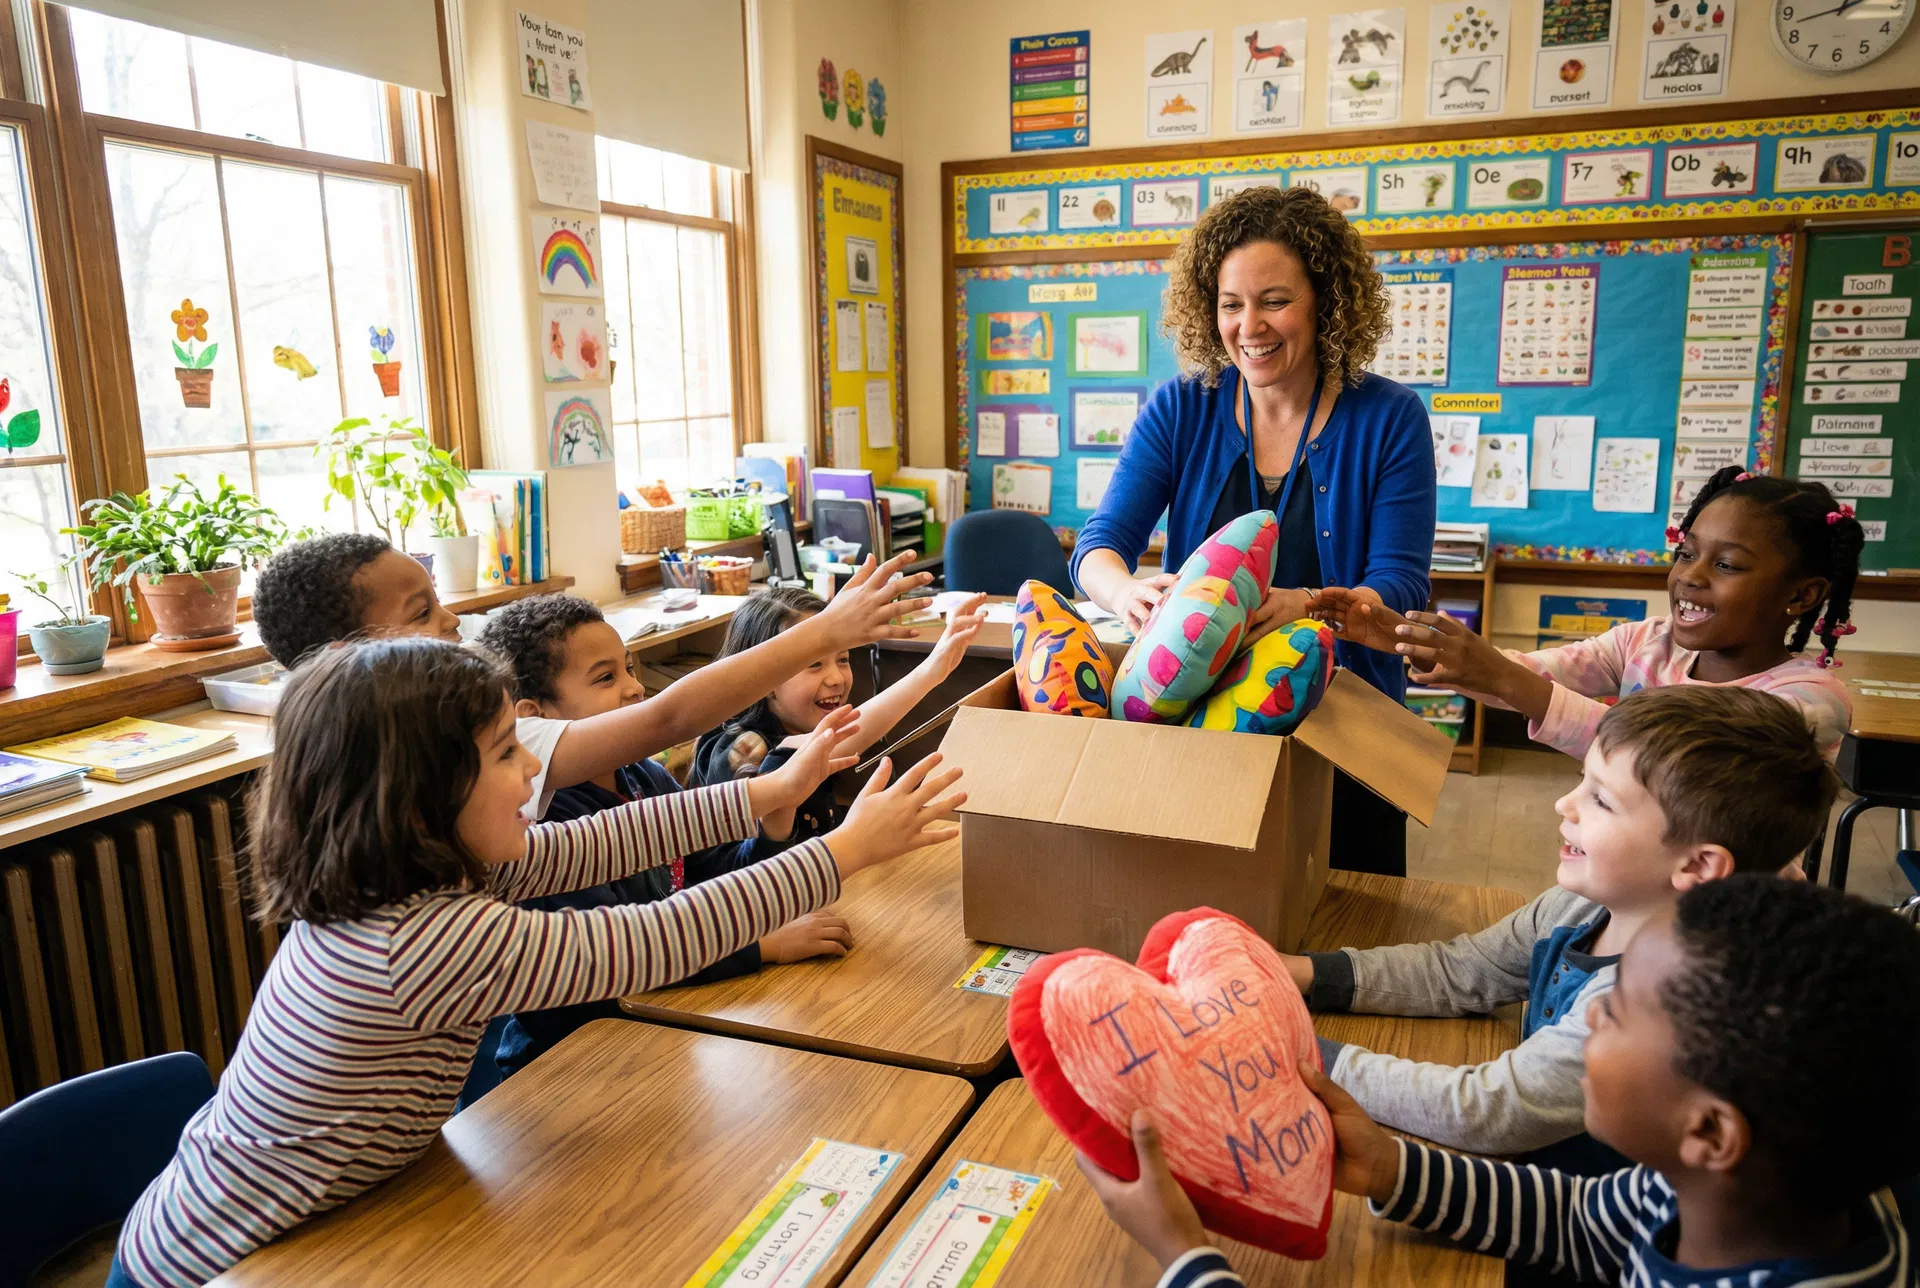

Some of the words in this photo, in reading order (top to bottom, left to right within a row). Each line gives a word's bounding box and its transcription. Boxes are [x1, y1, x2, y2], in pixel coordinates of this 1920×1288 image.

[1783, 6, 1794, 20] 9
[1879, 21, 1890, 35] 4
[1789, 29, 1800, 44] 8
[1808, 44, 1818, 58] 7
[1859, 40, 1870, 54] 5
[1832, 48, 1843, 62] 6
[1671, 154, 1701, 172] Ob
[1382, 173, 1404, 190] Sh
[1474, 168, 1501, 184] Oe
[1062, 195, 1079, 208] 22
[1882, 235, 1913, 268] B
[1091, 999, 1158, 1076] I
[1153, 978, 1261, 1039] Love
[1198, 1043, 1281, 1113] You
[1226, 1107, 1329, 1194] Mom
